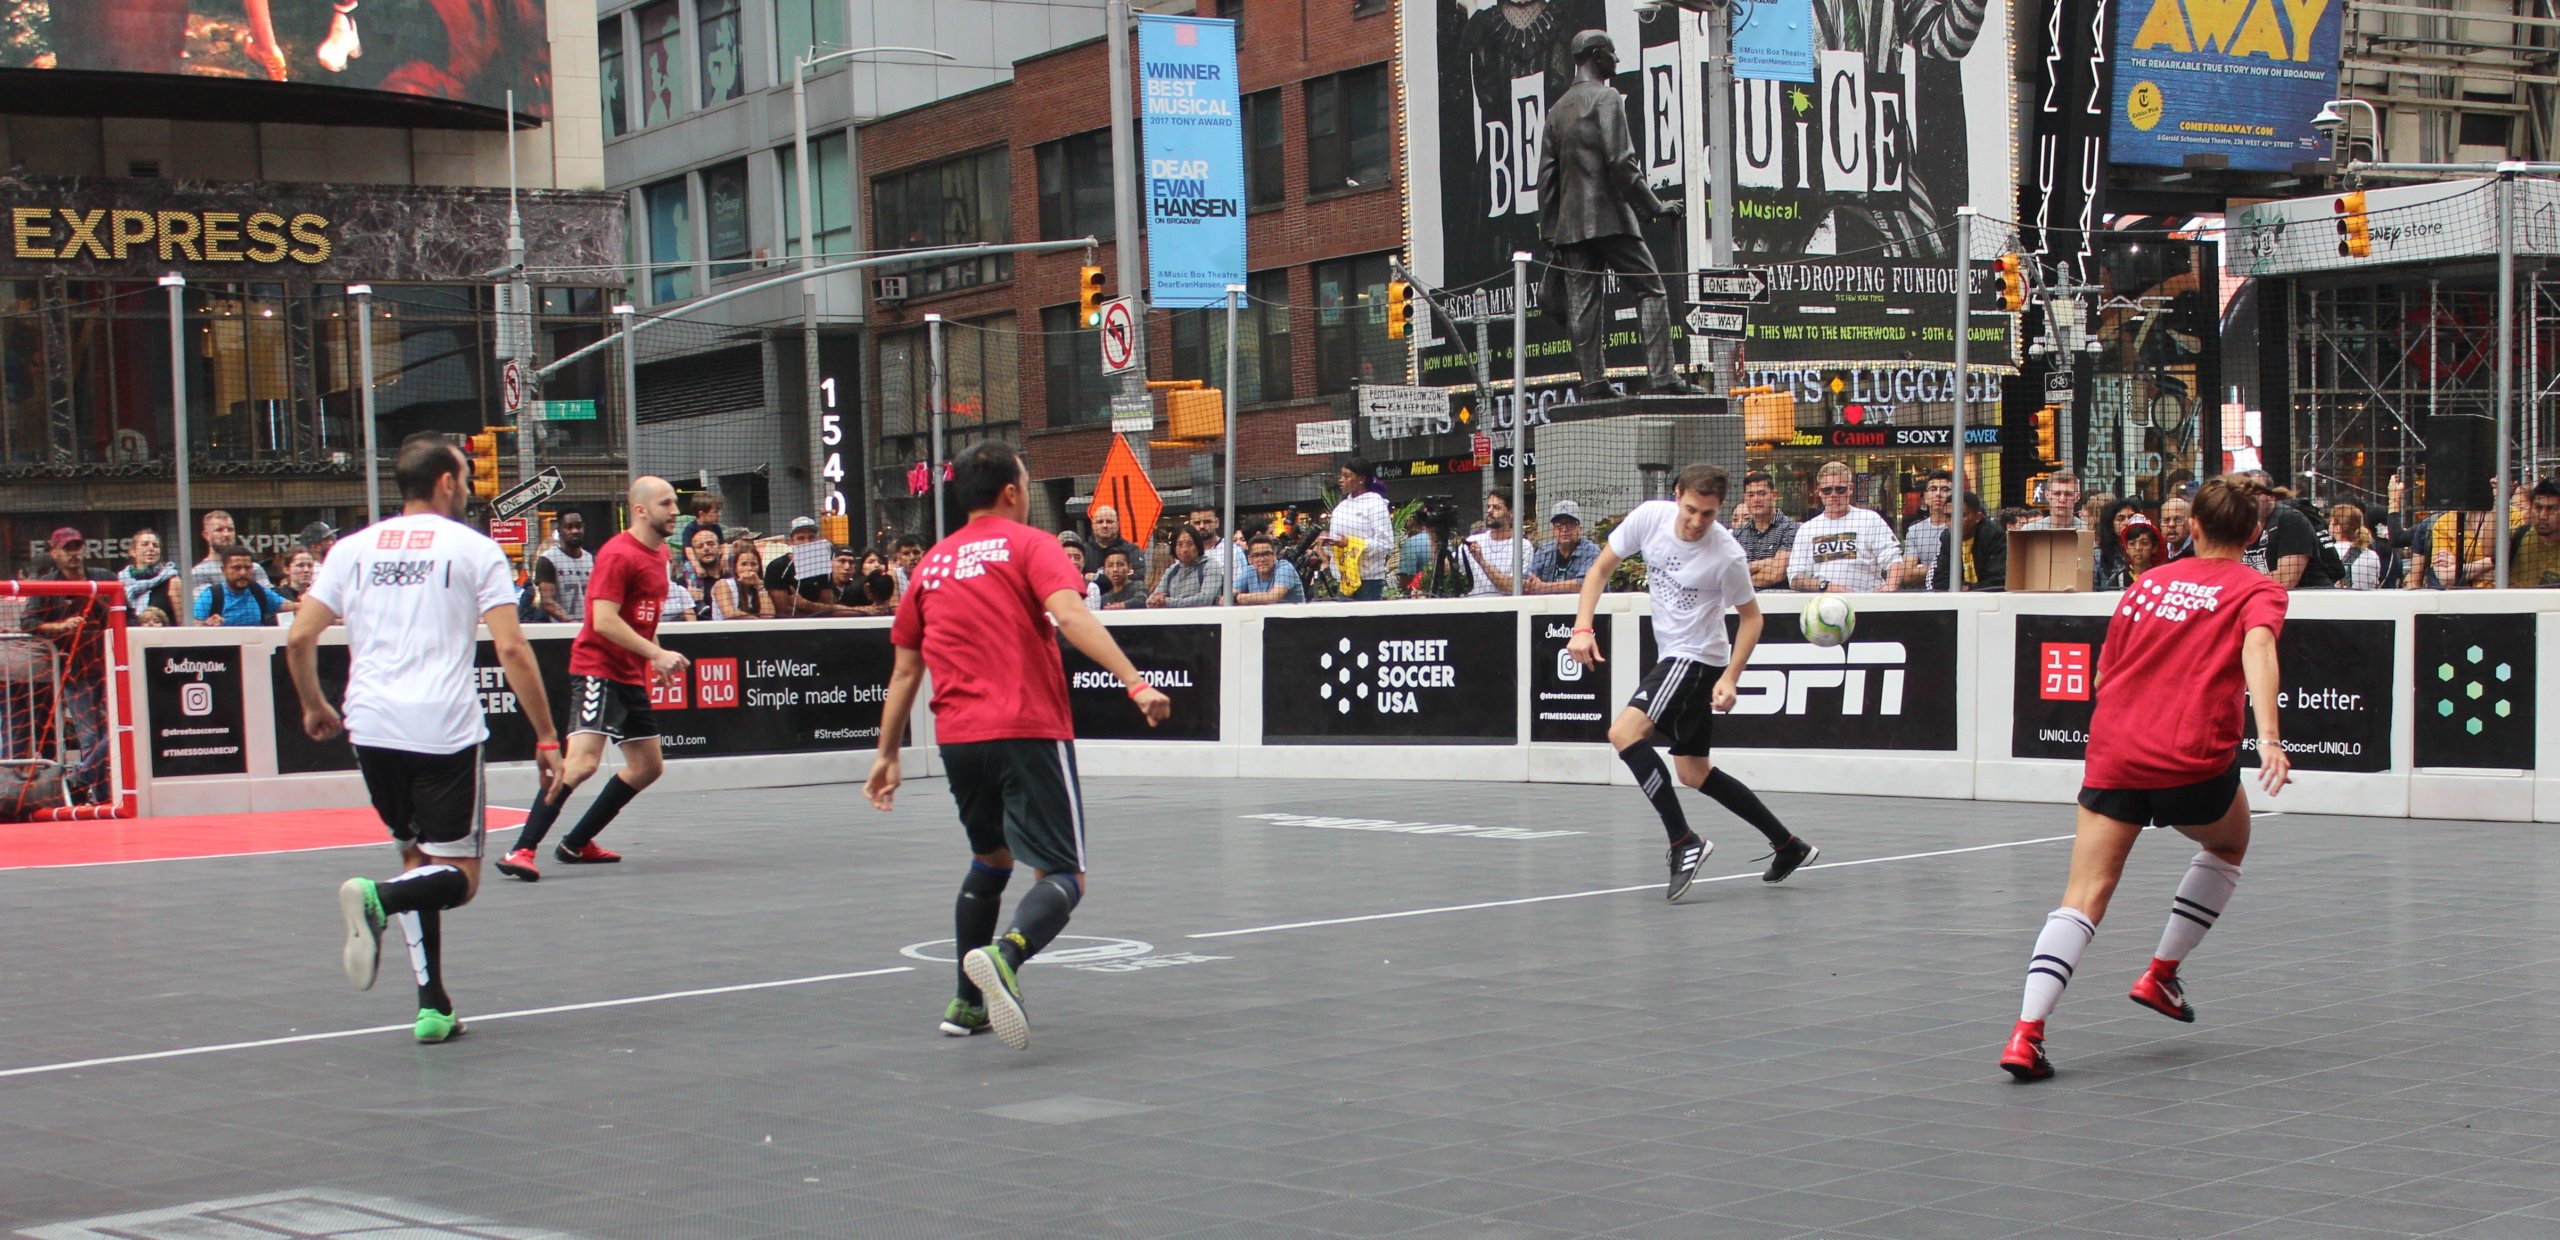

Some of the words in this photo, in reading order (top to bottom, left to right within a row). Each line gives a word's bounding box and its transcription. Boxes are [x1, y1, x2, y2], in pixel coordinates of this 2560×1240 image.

[1744, 47, 1764, 55] Music
[1766, 48, 1780, 56] Box
[1782, 49, 1806, 58] Theatre
[1738, 56, 1807, 67] DearEvanHansen.com
[2131, 57, 2146, 67] THE
[2148, 59, 2201, 71] REMARKABLE
[2202, 63, 2223, 72] TRUE
[2223, 65, 2250, 75] STORY
[2250, 67, 2269, 77] NOW
[2270, 69, 2282, 78] ON
[2283, 70, 2325, 80] BROADWAY
[1146, 62, 1220, 80] WINNER
[1147, 80, 1197, 97] BEST
[1148, 98, 1232, 116] MUSICAL
[1150, 116, 1169, 125] 2017
[1171, 117, 1196, 126] TONY
[1198, 118, 1232, 126] AWARD
[2178, 120, 2274, 136] COMEFROMAWAY.COM
[2161, 134, 2180, 143] Gerald
[2244, 139, 2261, 147] WEST
[2273, 141, 2294, 149] STREET
[1151, 159, 1209, 179] DEAR
[1153, 179, 1205, 198] EVAN
[1153, 197, 1237, 218] HANSEN
[1738, 200, 1802, 220] Musical.
[11, 207, 332, 264] EXPRESS
[2404, 222, 2443, 237] store
[1163, 270, 1189, 279] Music
[1190, 271, 1205, 279] Box
[1207, 271, 1239, 279] Theatre
[1758, 262, 1885, 292] AW-DROPPING
[1157, 280, 1227, 289] DearEvanHansen.c
[1708, 277, 1729, 292] ONE
[1737, 278, 1757, 292] WAY
[1691, 313, 1709, 328] ONE
[1717, 314, 1739, 329] WAY
[1759, 325, 1781, 339] THIS
[1782, 325, 1803, 340] WAY
[1805, 326, 1819, 339] TO
[1820, 326, 1838, 340] THE
[1839, 326, 1906, 340] NETHERWORLD
[1921, 327, 1944, 341] 50TH
[1946, 328, 1954, 341] &
[1967, 327, 2005, 342] OADWAY
[1424, 356, 1440, 371] NOW
[1442, 355, 1453, 369] ON
[1542, 340, 1572, 355] GARDEN
[1609, 331, 1628, 346] 50TH
[1630, 330, 1637, 345] &
[1849, 369, 2003, 403] LUGGAGE
[1428, 391, 1446, 401] ZONE
[559, 403, 566, 417] 7
[1421, 404, 1446, 414] MOVING
[1863, 405, 1897, 425] NY
[1782, 430, 1823, 446] ikon
[1832, 430, 1886, 446] Canon
[1896, 429, 1950, 445] SONY
[1964, 429, 1997, 443] OWER
[820, 377, 846, 517] 1540
[1383, 465, 1402, 477] Apple
[1410, 460, 1440, 476] Nikon
[501, 495, 523, 512] ONE
[529, 478, 551, 496] WAY
[957, 538, 1008, 557] STREET
[373, 560, 435, 575] STADIUM
[956, 550, 1010, 568] SOCCER
[373, 573, 426, 586] GOODS
[954, 564, 987, 580] USA
[2167, 580, 2223, 598] STREET
[2161, 592, 2219, 612] SOCCR
[2154, 604, 2187, 622] USA
[1545, 622, 1580, 639] Insta
[1377, 639, 1448, 663] STREET
[2047, 650, 2083, 670] ユニ
[165, 658, 227, 681] Instagram
[700, 664, 731, 681] UNI
[745, 659, 821, 679] LifeWear.
[1377, 664, 1456, 689] SOCCER
[1712, 641, 1907, 715] SPN
[2046, 673, 2083, 694] クロ
[702, 684, 735, 701] QLO
[747, 688, 799, 710] Simple
[805, 686, 847, 703] made
[853, 684, 889, 703] bette
[1539, 692, 1595, 701] @streetsoccerusa
[2298, 687, 2364, 711] better.
[1377, 690, 1419, 714] USA
[1539, 712, 1602, 721] #TIMESSQUARECUP
[162, 727, 229, 737] @streetsoccerusa
[814, 727, 882, 739] #StreetSoccerUN
[2039, 728, 2089, 744] UNIQLO.c
[660, 735, 706, 747] IQLO.com
[163, 746, 239, 757] #TIMESSQUARECUP
